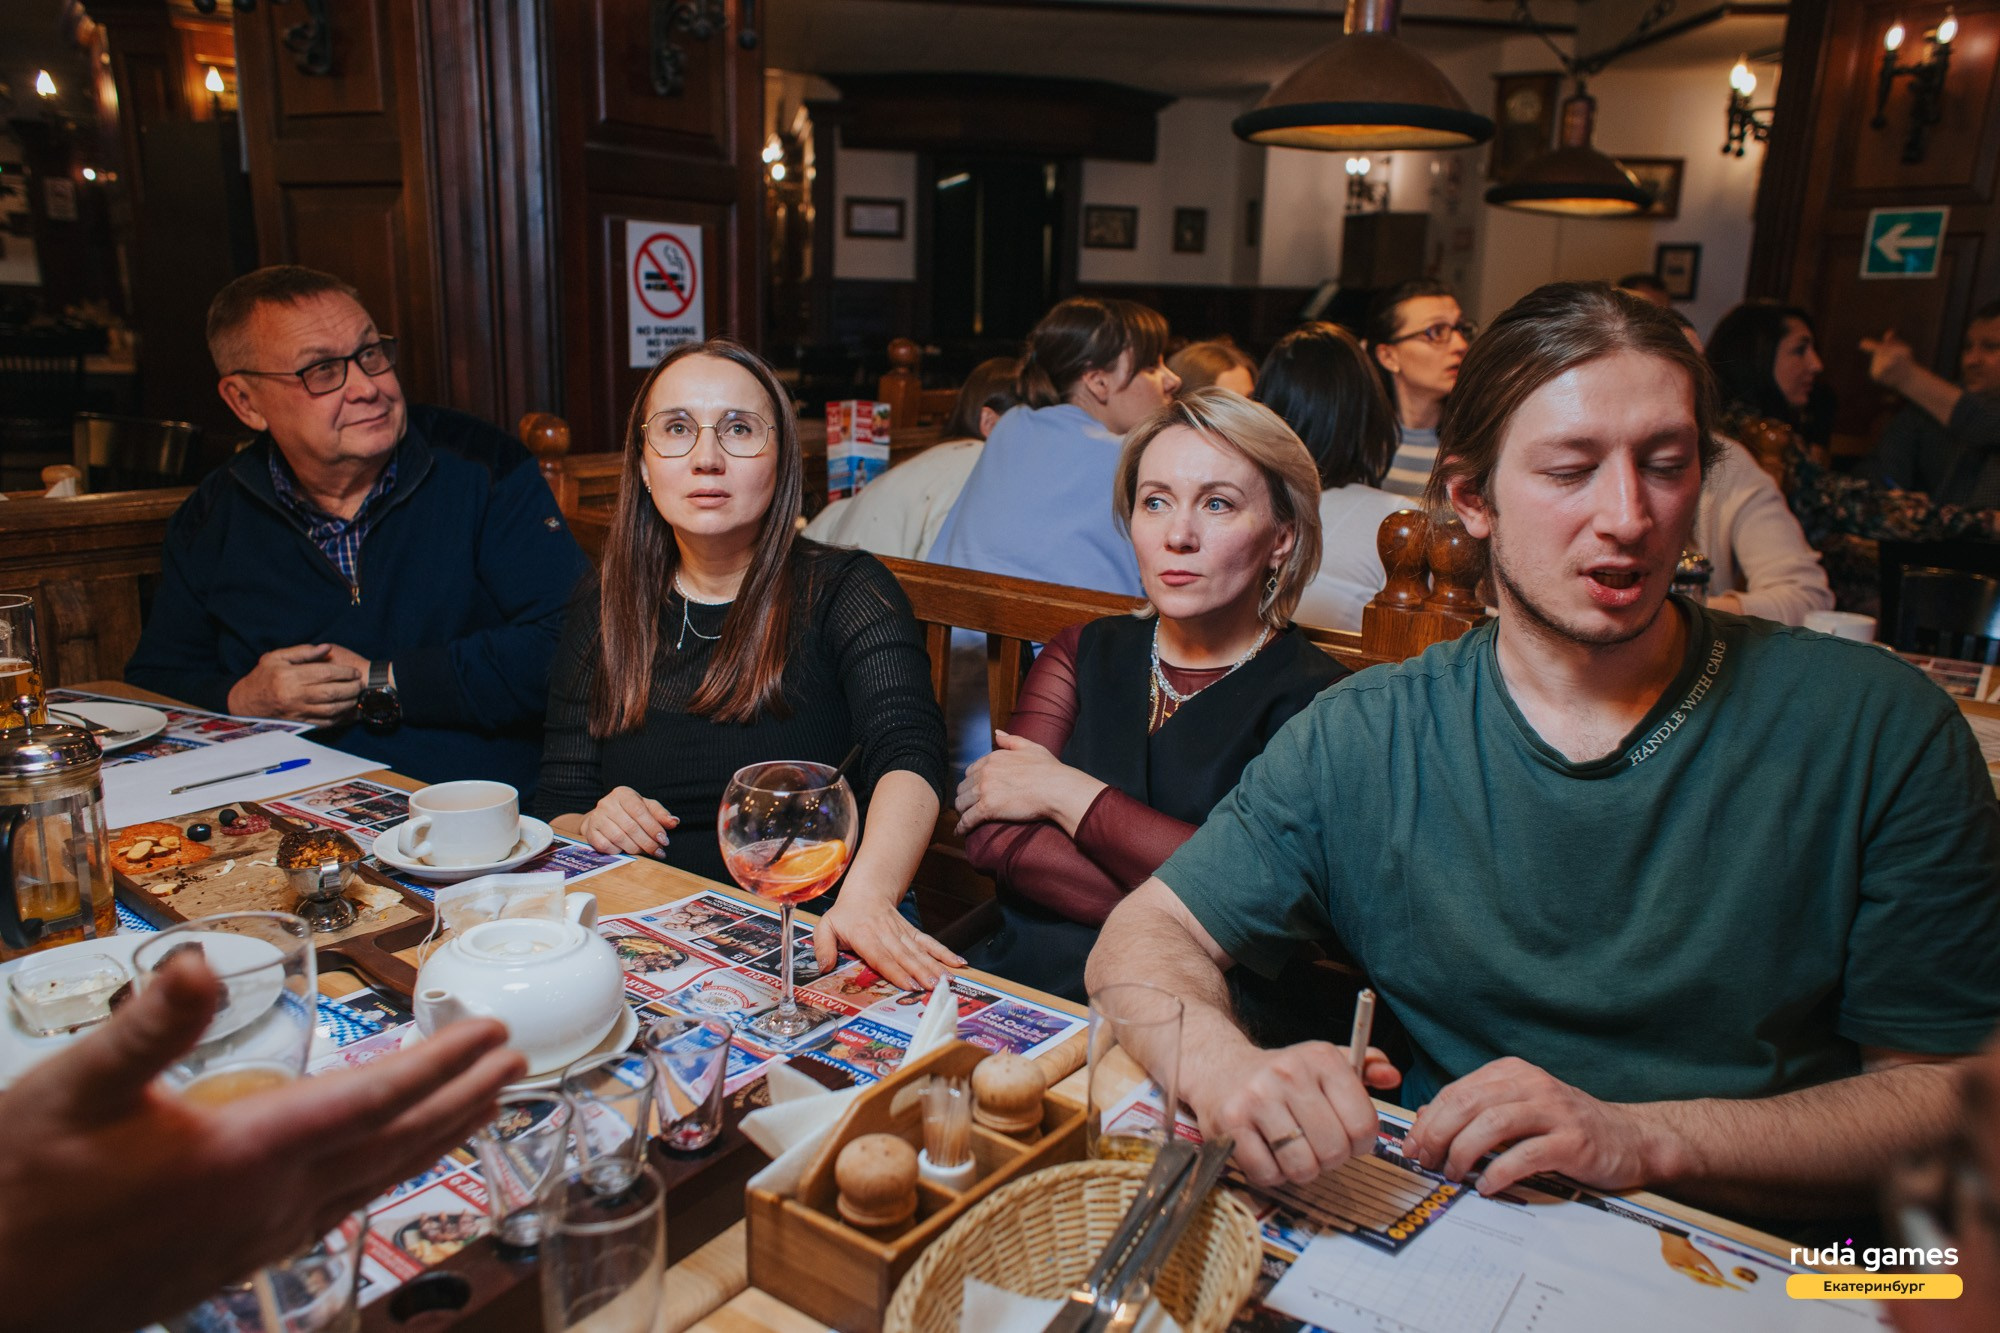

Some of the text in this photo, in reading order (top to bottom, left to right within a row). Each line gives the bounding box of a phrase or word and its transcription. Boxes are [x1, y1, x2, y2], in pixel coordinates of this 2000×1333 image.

[636, 325, 696, 336] NO SMOKING
[1629, 640, 1727, 767] HANDLE WITH CARE
[651, 990, 664, 999] 6
[847, 1023, 911, 1049] ОЗРАСТУ
